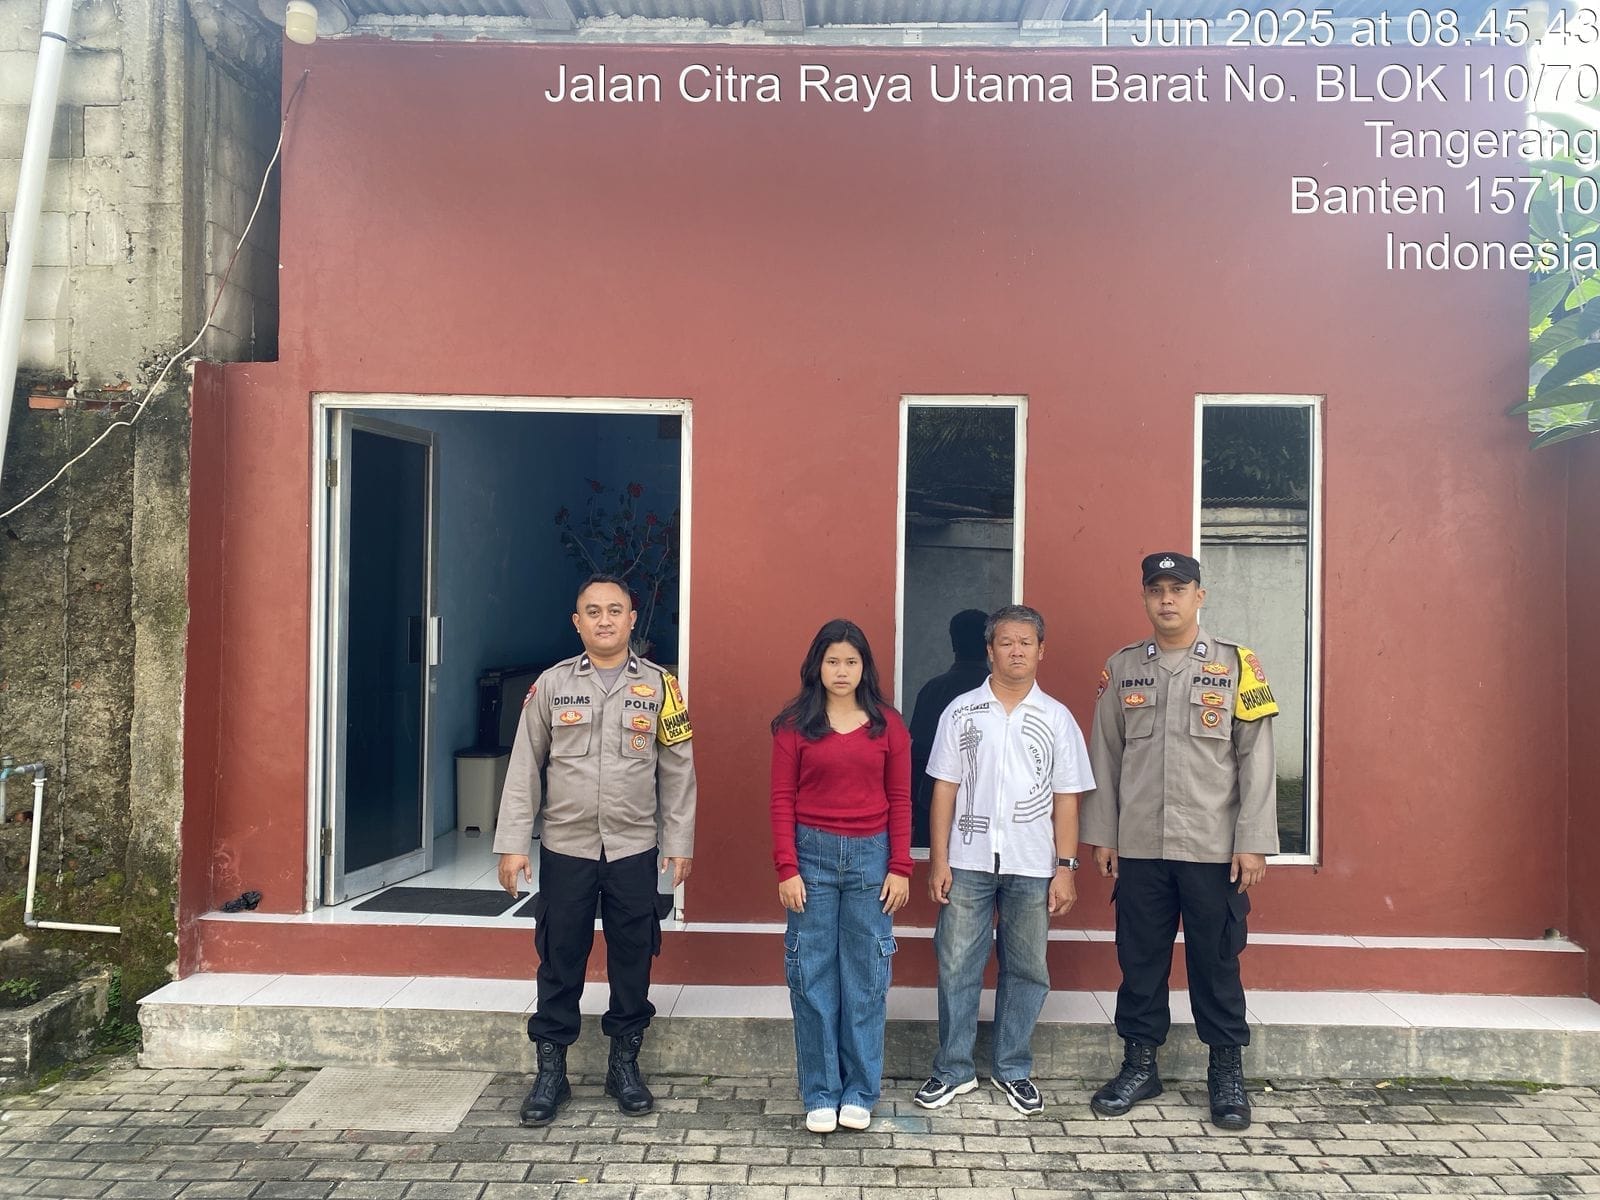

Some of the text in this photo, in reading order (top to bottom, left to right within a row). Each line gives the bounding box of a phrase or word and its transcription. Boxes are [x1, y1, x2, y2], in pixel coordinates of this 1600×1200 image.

[1121, 678, 1155, 688] IBNU
[1192, 676, 1232, 688] POLRI
[554, 695, 591, 706] DIDI.MS
[624, 699, 659, 712] POLRI
